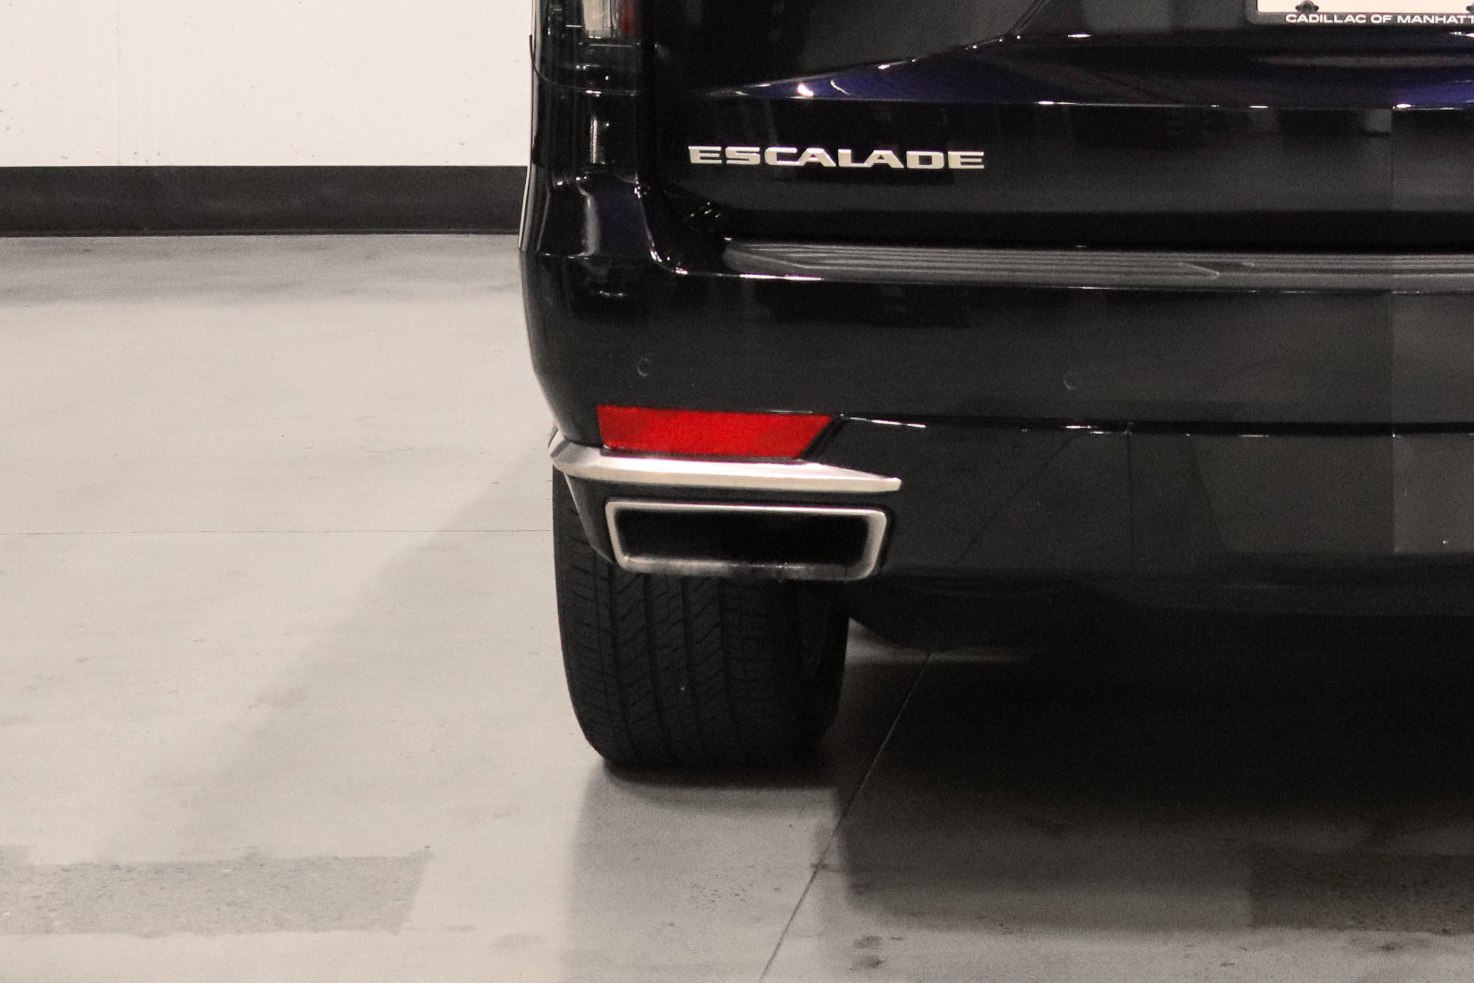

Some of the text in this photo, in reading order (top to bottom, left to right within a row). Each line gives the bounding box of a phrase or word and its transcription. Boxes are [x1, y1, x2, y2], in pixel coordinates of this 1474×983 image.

[1284, 13, 1367, 24] CADILLAC
[1369, 13, 1393, 24] OF
[687, 145, 985, 170] ESCALADE
